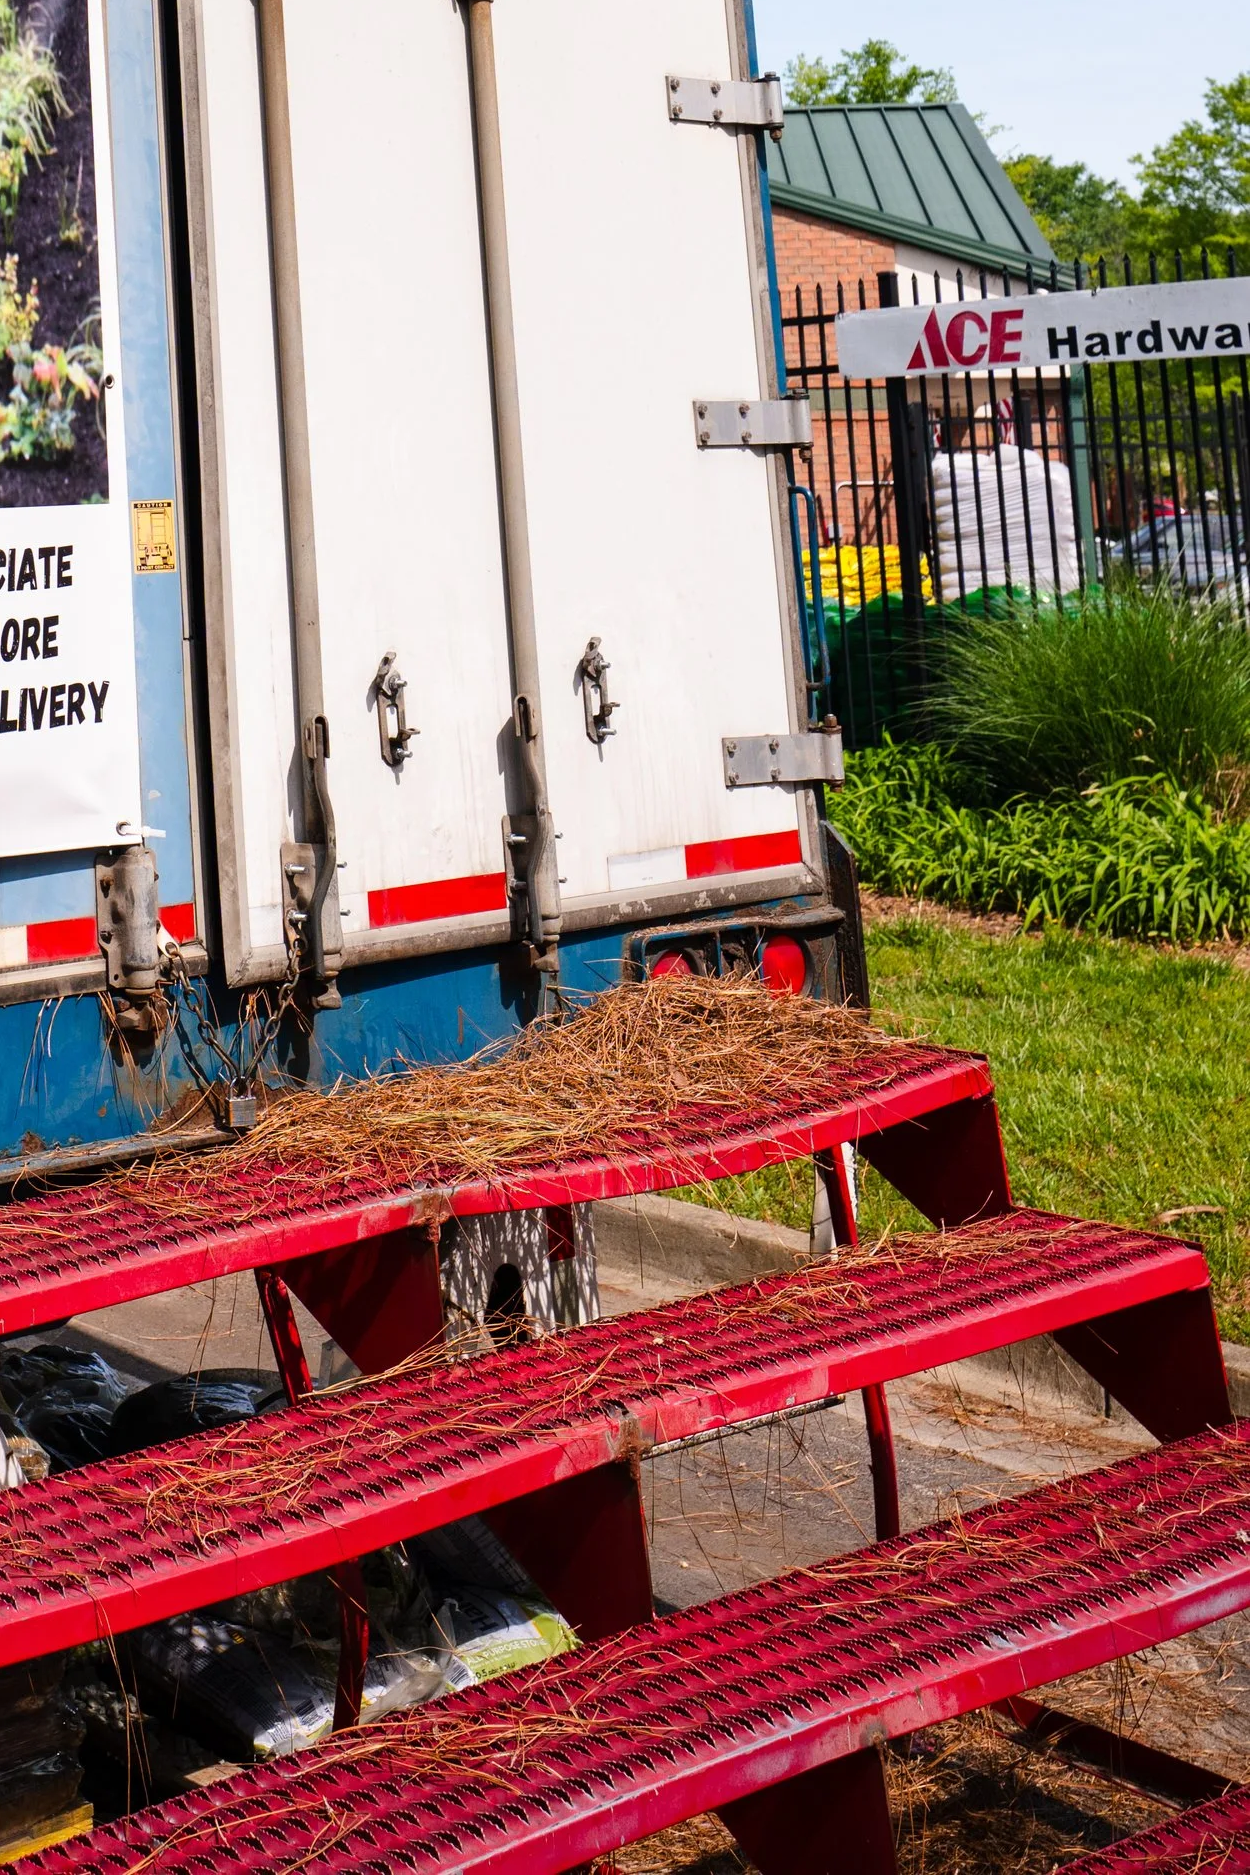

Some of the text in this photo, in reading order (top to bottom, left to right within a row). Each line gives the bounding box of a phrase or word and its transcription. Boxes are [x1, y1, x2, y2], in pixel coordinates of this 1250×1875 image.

[906, 307, 1250, 371] ACE Hardwa
[484, 1640, 519, 1658] PURPOSE
